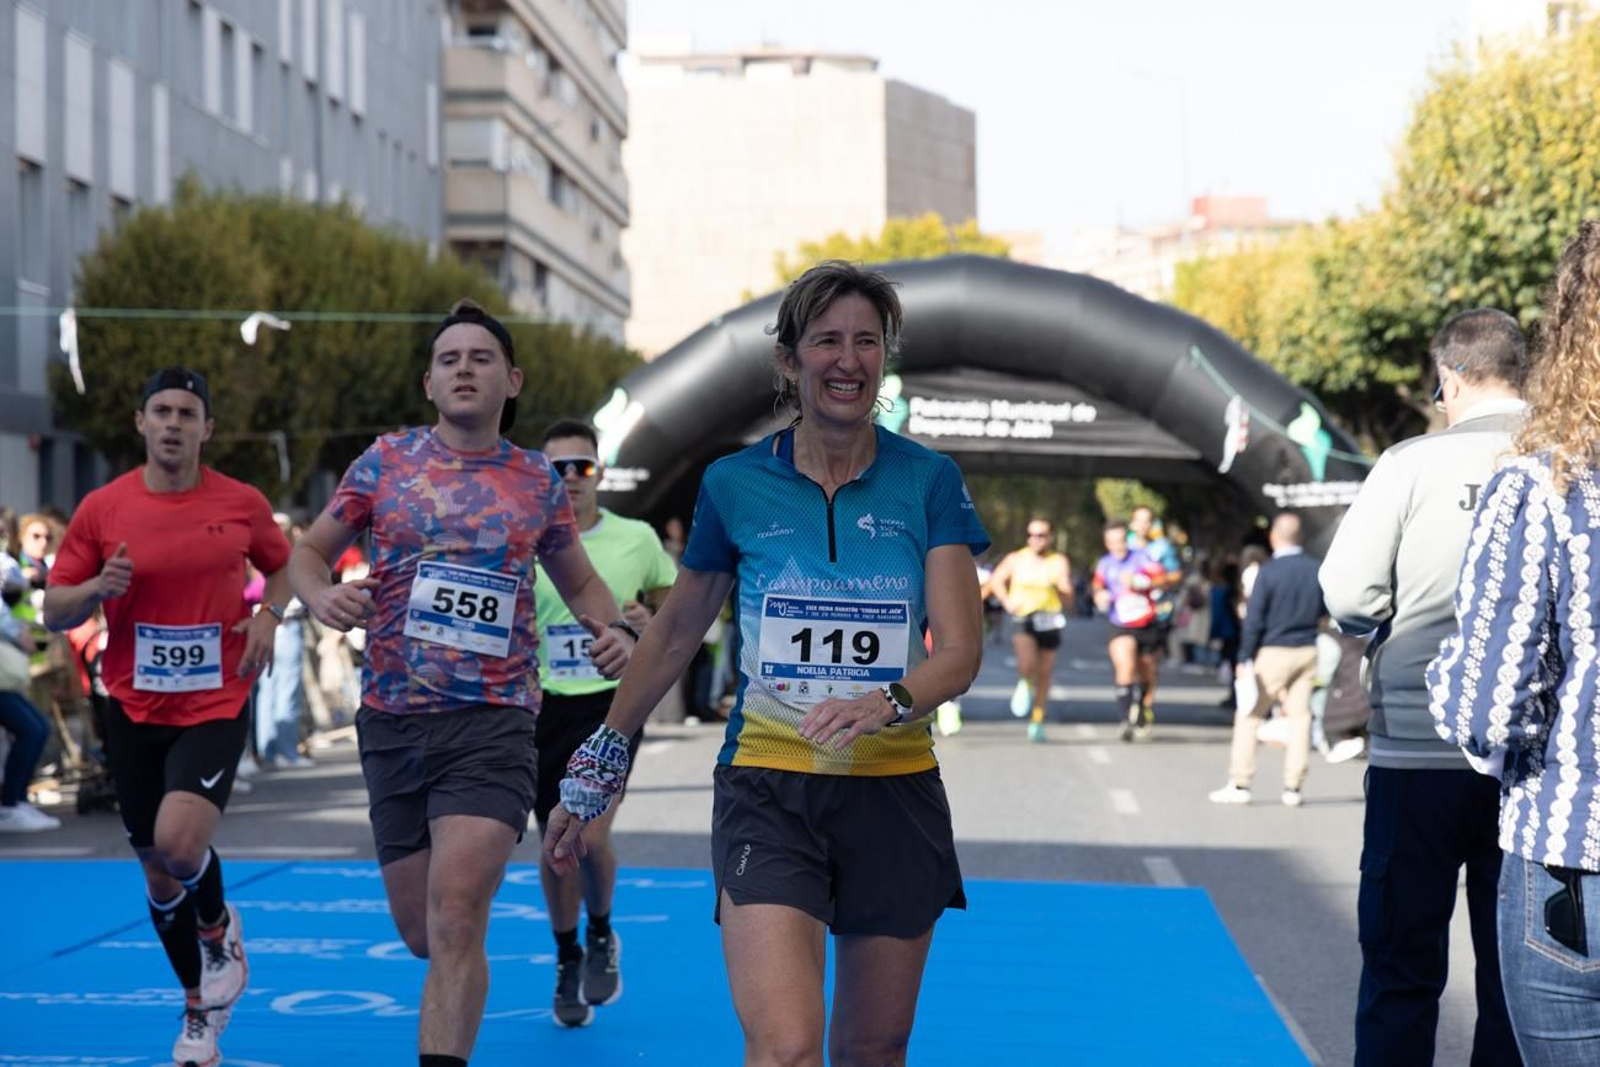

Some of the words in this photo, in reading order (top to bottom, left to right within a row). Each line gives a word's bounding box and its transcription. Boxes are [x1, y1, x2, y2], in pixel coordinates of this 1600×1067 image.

[432, 587, 499, 623] 558
[151, 644, 206, 667] 599
[563, 638, 594, 659] 15
[791, 627, 880, 666] 119
[797, 666, 828, 676] NOELIA
[829, 667, 870, 678] PATRICIA
